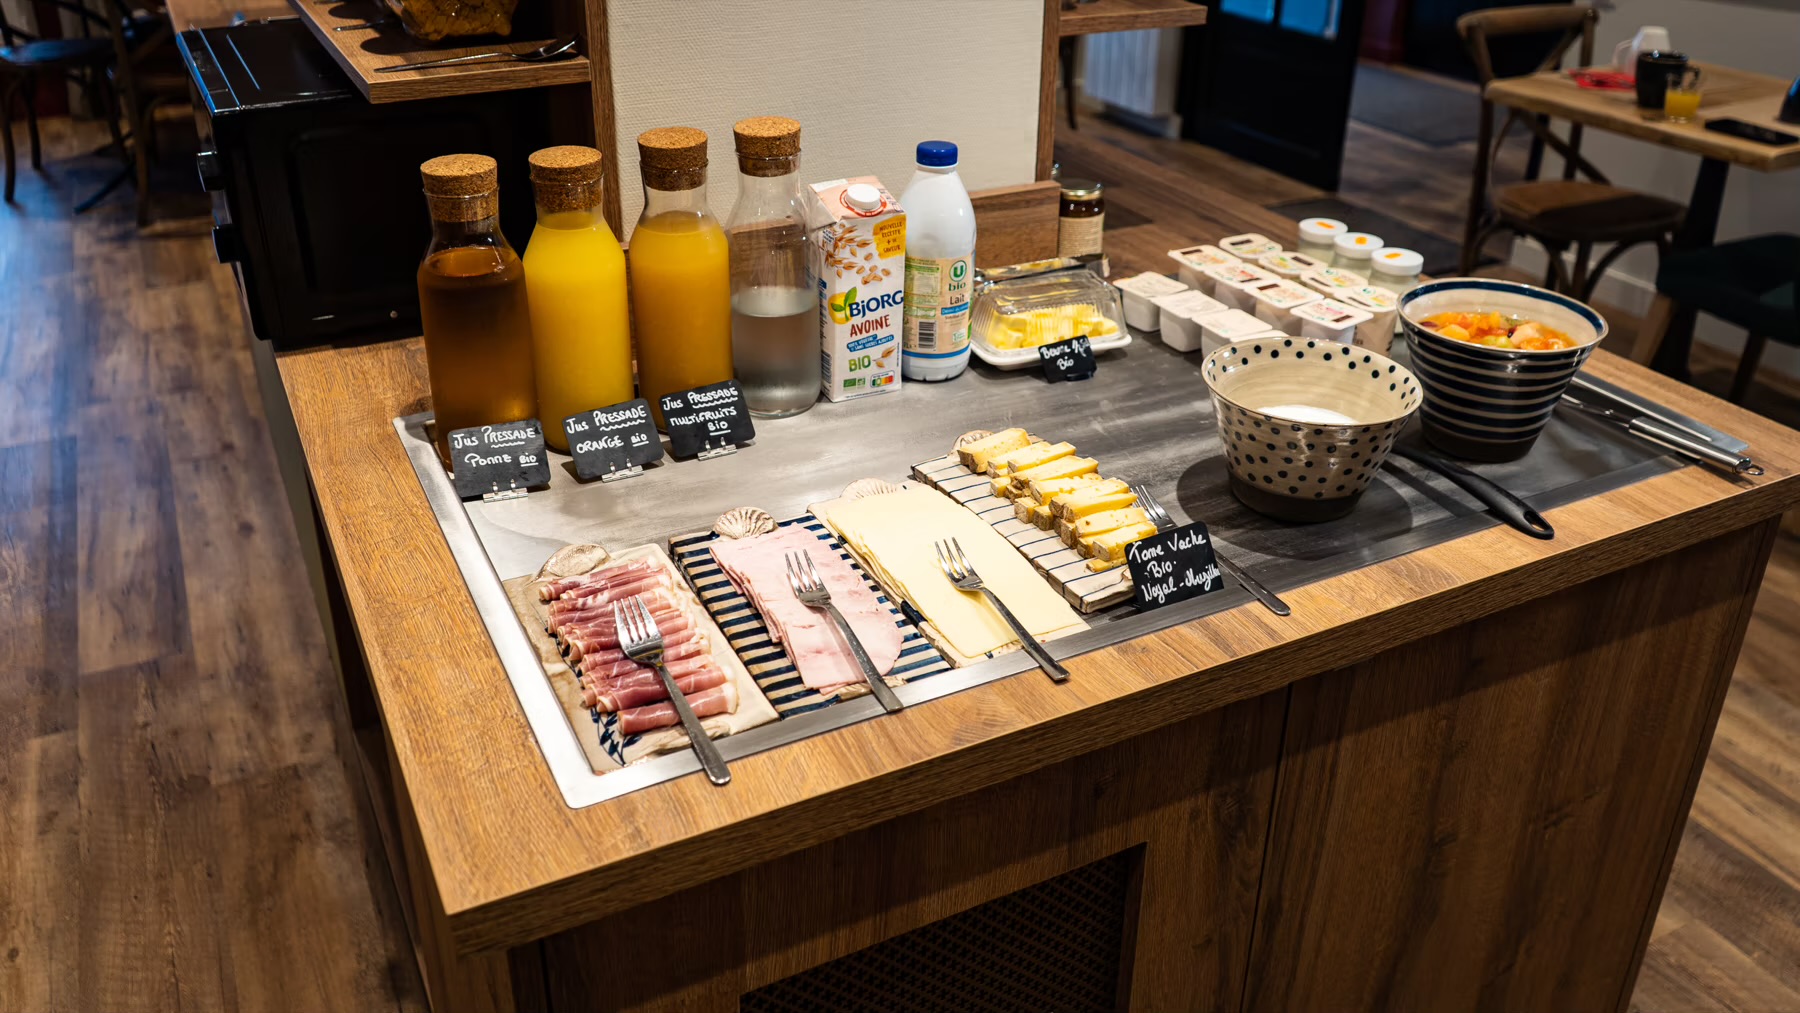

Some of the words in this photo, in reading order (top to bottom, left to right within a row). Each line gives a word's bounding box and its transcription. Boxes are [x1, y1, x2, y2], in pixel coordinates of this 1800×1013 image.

[948, 282, 966, 291] bio
[950, 293, 965, 305] Lait
[850, 314, 890, 337] AVOINE
[848, 354, 871, 372] BIO
[662, 397, 684, 410] Jus
[687, 387, 738, 404] PRESSADE
[566, 418, 589, 434] Jus
[593, 405, 647, 426] PRESSADE
[453, 434, 479, 449] Jus
[481, 426, 536, 443] PRESSADE
[576, 435, 624, 453] ORANGE
[1129, 541, 1164, 563] Tome
[1167, 529, 1206, 551] Vache
